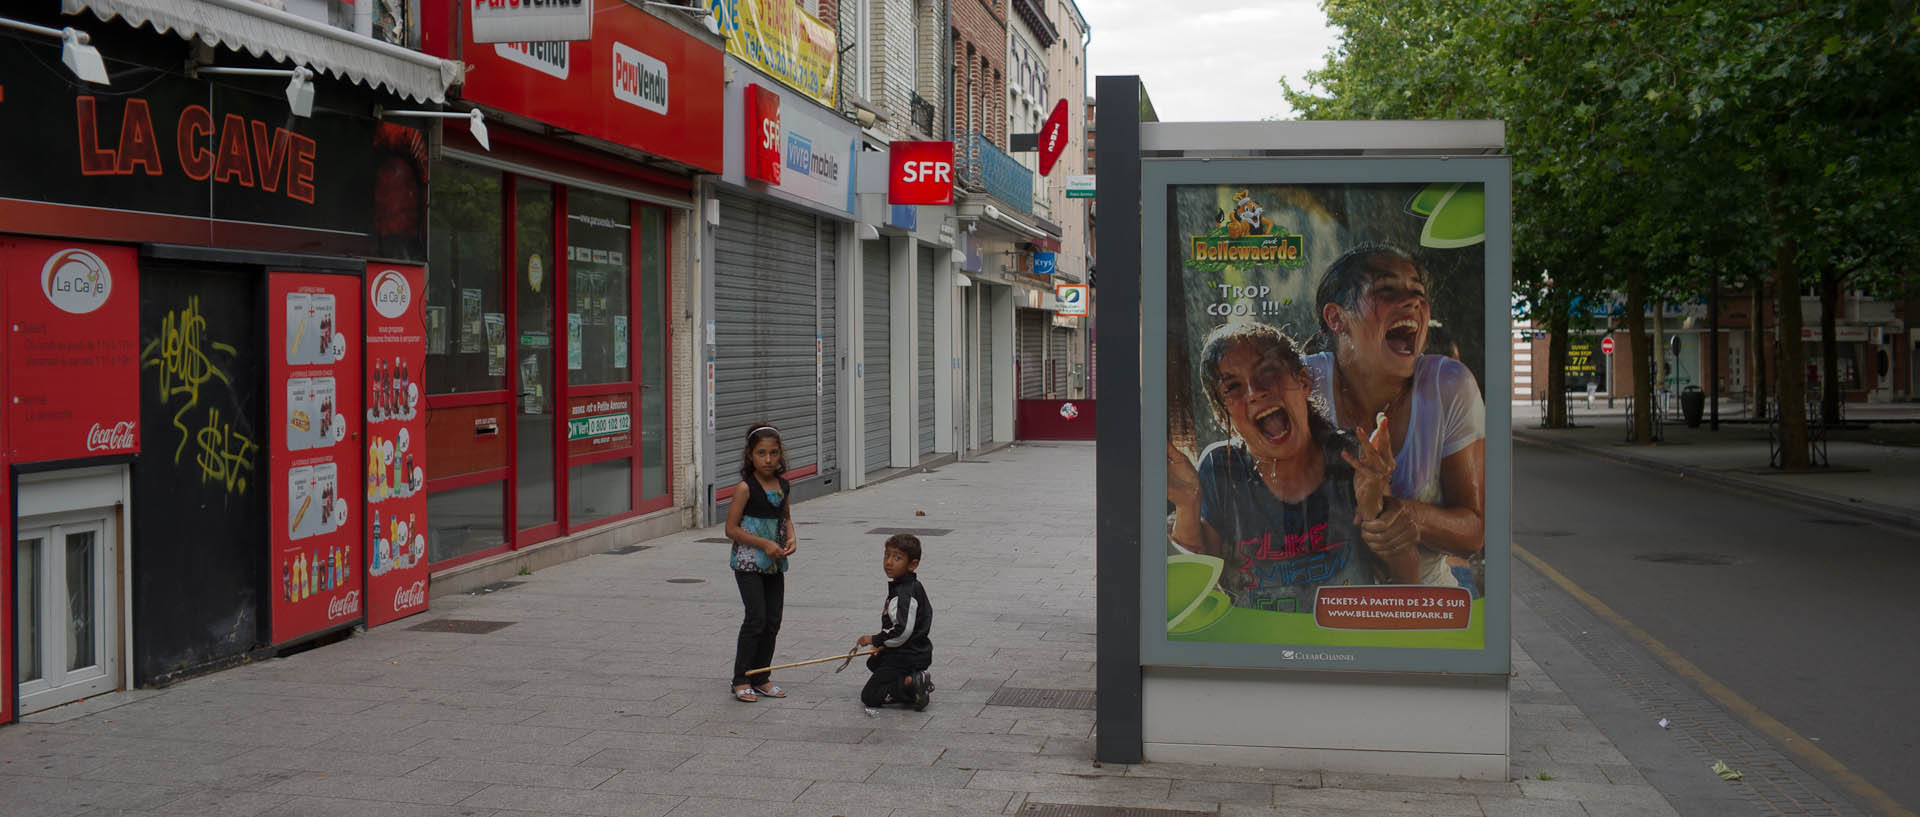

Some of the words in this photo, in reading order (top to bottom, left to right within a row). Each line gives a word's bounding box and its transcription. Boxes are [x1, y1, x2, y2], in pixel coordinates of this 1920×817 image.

[615, 52, 667, 107] ParuVendu
[1047, 122, 1061, 152] TABAC
[76, 95, 163, 176] LA
[177, 104, 317, 205] CAVE
[788, 139, 809, 170] vivre
[811, 151, 839, 181] mobile
[903, 160, 951, 183] SFR
[1196, 240, 1298, 261] Bellewaerde
[1034, 258, 1052, 267] Krys
[56, 276, 71, 293] La
[379, 291, 388, 303] La
[1572, 356, 1588, 366] 7/7
[1320, 597, 1358, 605] TICKETS
[1370, 598, 1404, 606] PARTIR
[1422, 597, 1435, 606] 23
[1436, 598, 1444, 607] €
[1446, 599, 1465, 607] SUR
[1328, 610, 1455, 620] WWW.BELLEWAERDEPARK.BE
